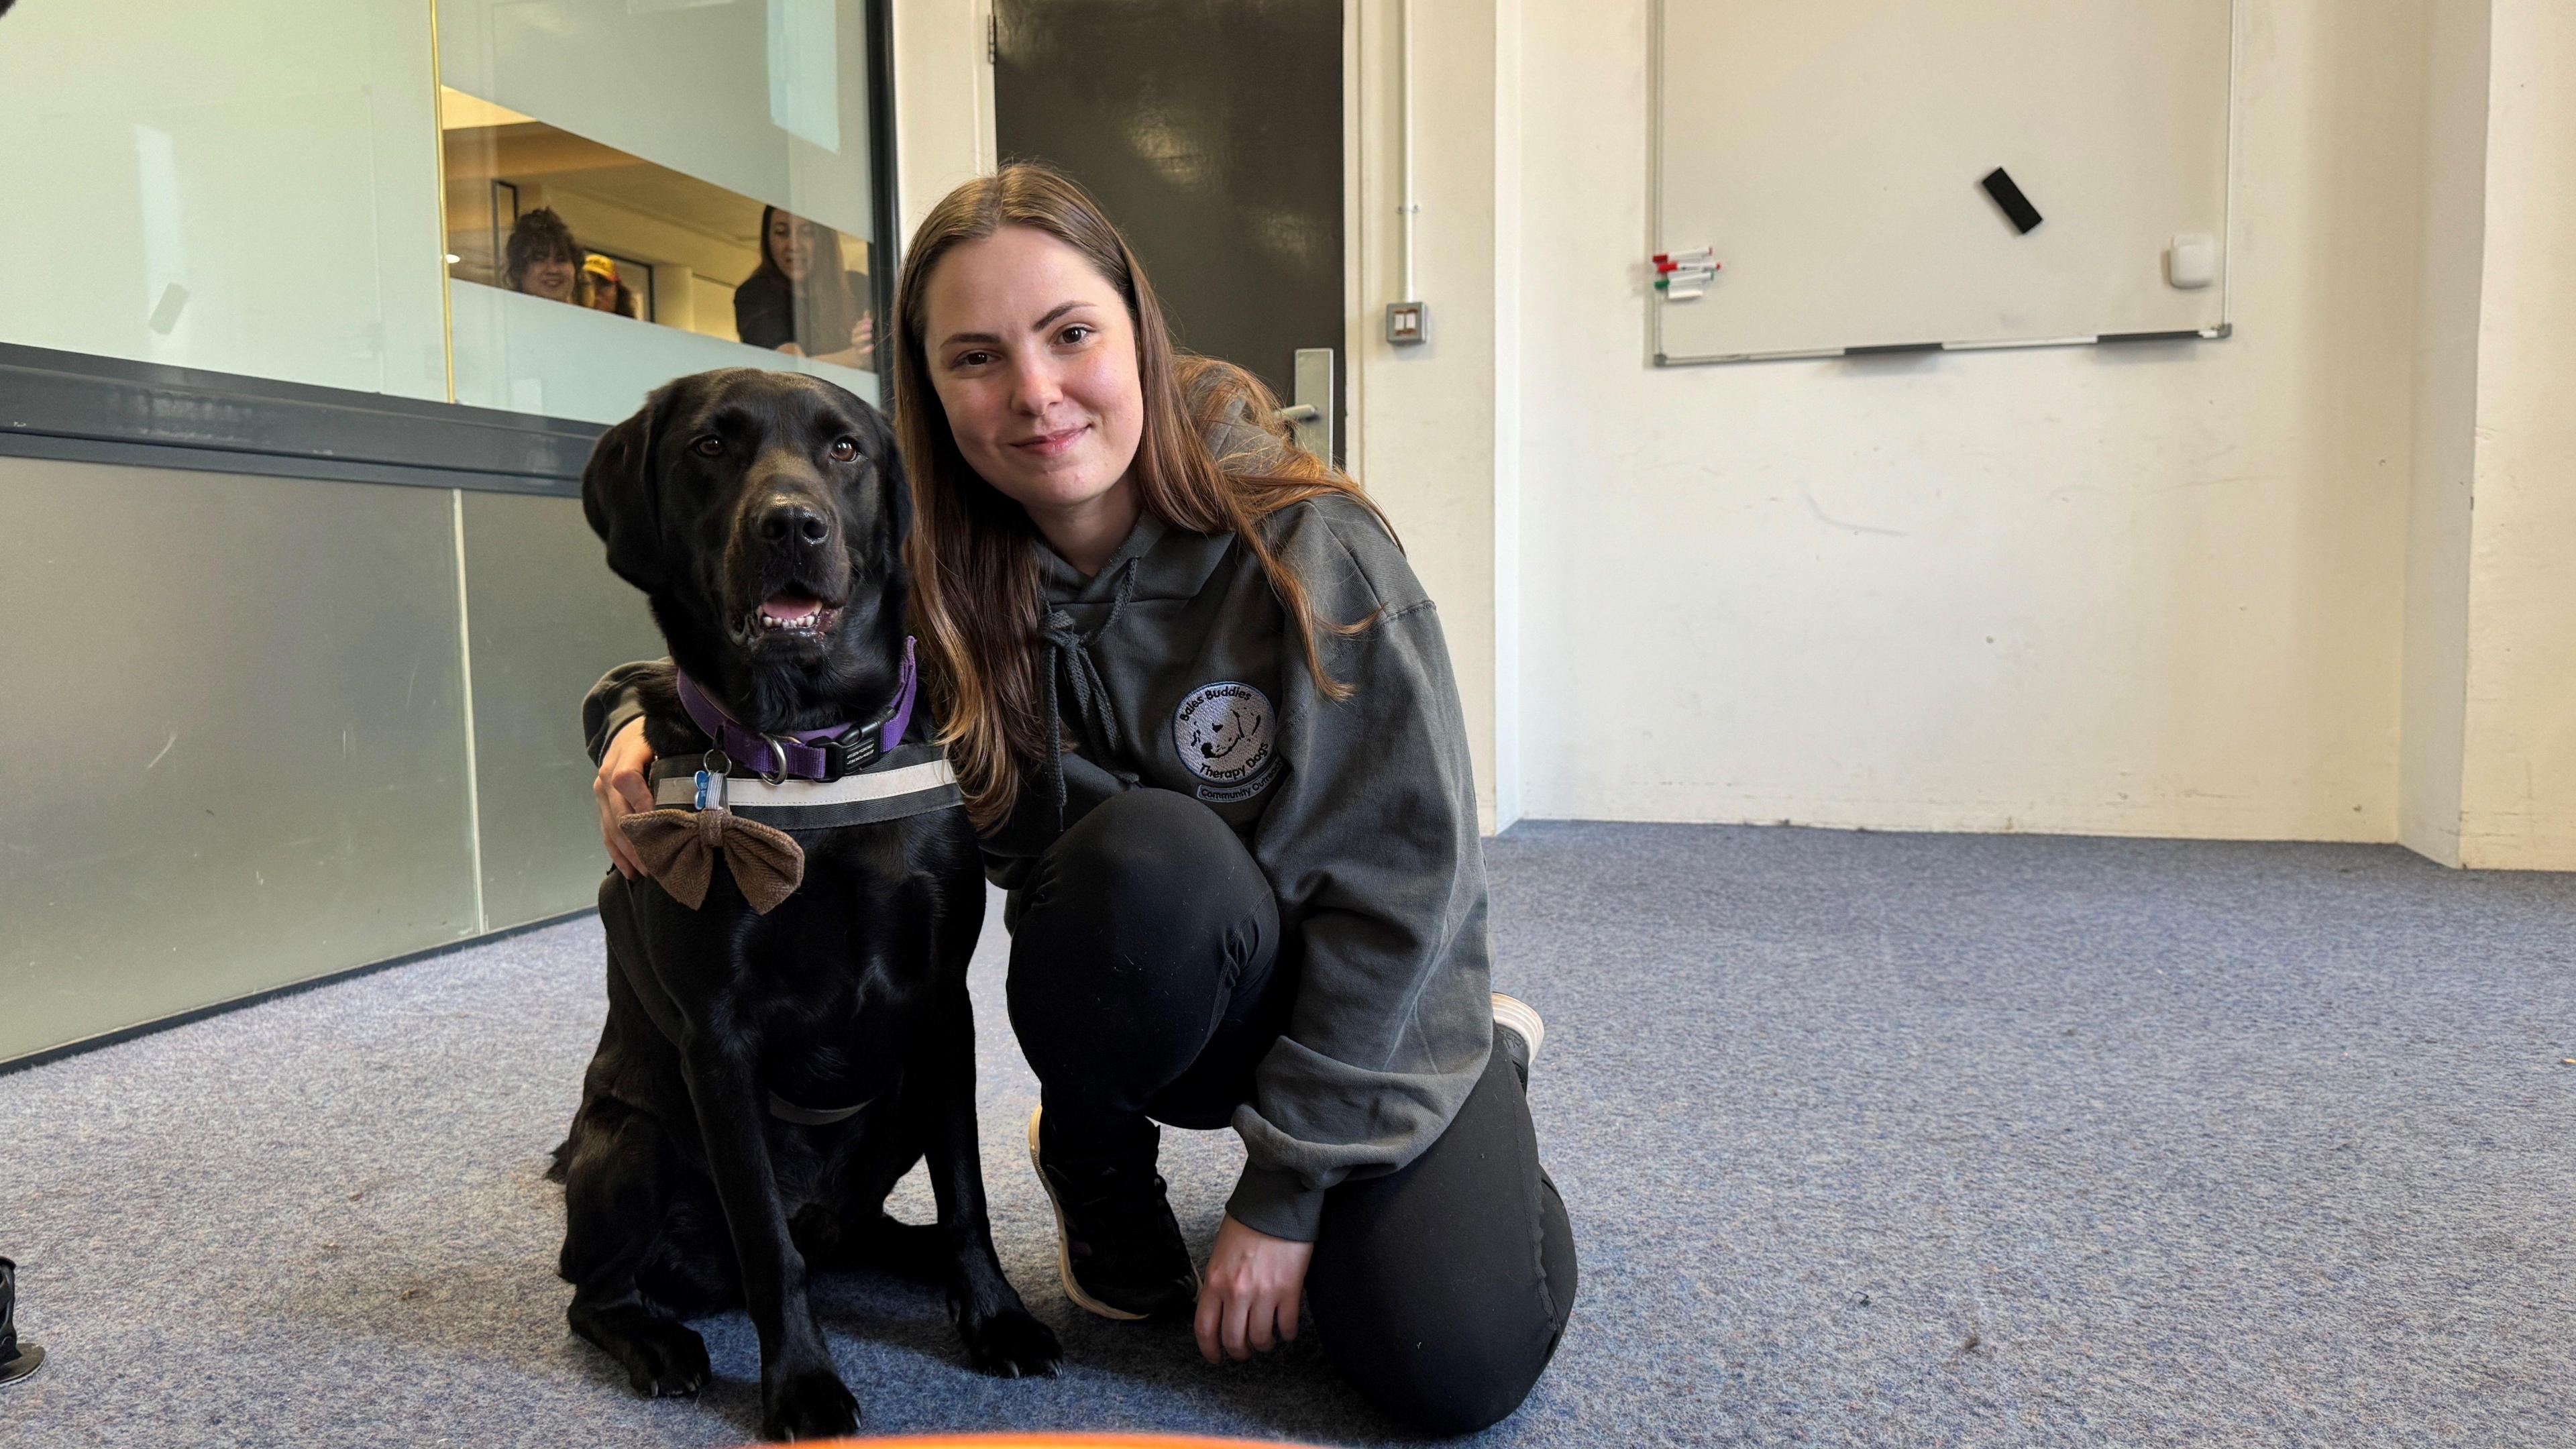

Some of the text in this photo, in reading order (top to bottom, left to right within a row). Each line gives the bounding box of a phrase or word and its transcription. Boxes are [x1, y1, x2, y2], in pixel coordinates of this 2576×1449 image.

[1179, 686, 1251, 721] Bales Buddies
[1200, 743, 1269, 780] Therapy Dogs
[1201, 788, 1251, 799] Community
